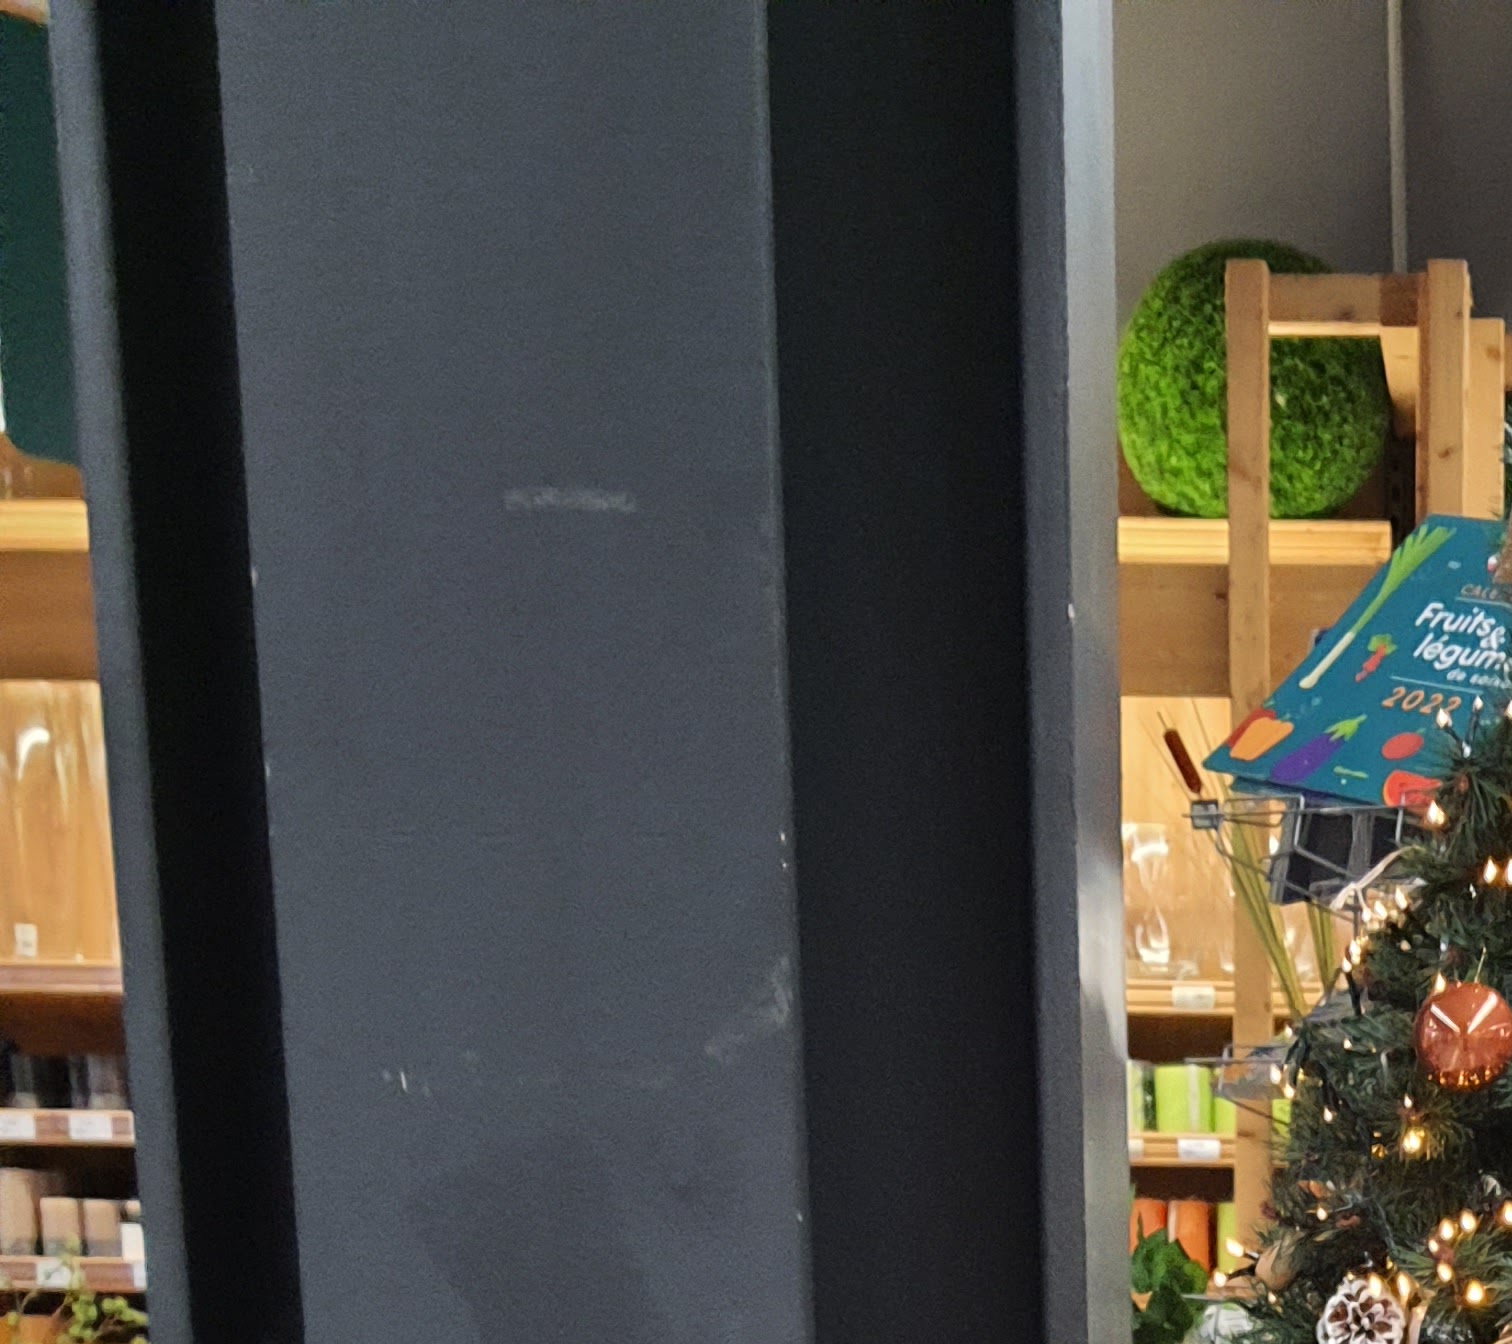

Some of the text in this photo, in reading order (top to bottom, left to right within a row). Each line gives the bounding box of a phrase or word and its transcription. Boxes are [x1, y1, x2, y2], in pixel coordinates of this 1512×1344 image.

[1414, 602, 1506, 650] Fruits &
[1382, 686, 1462, 715] 2022
